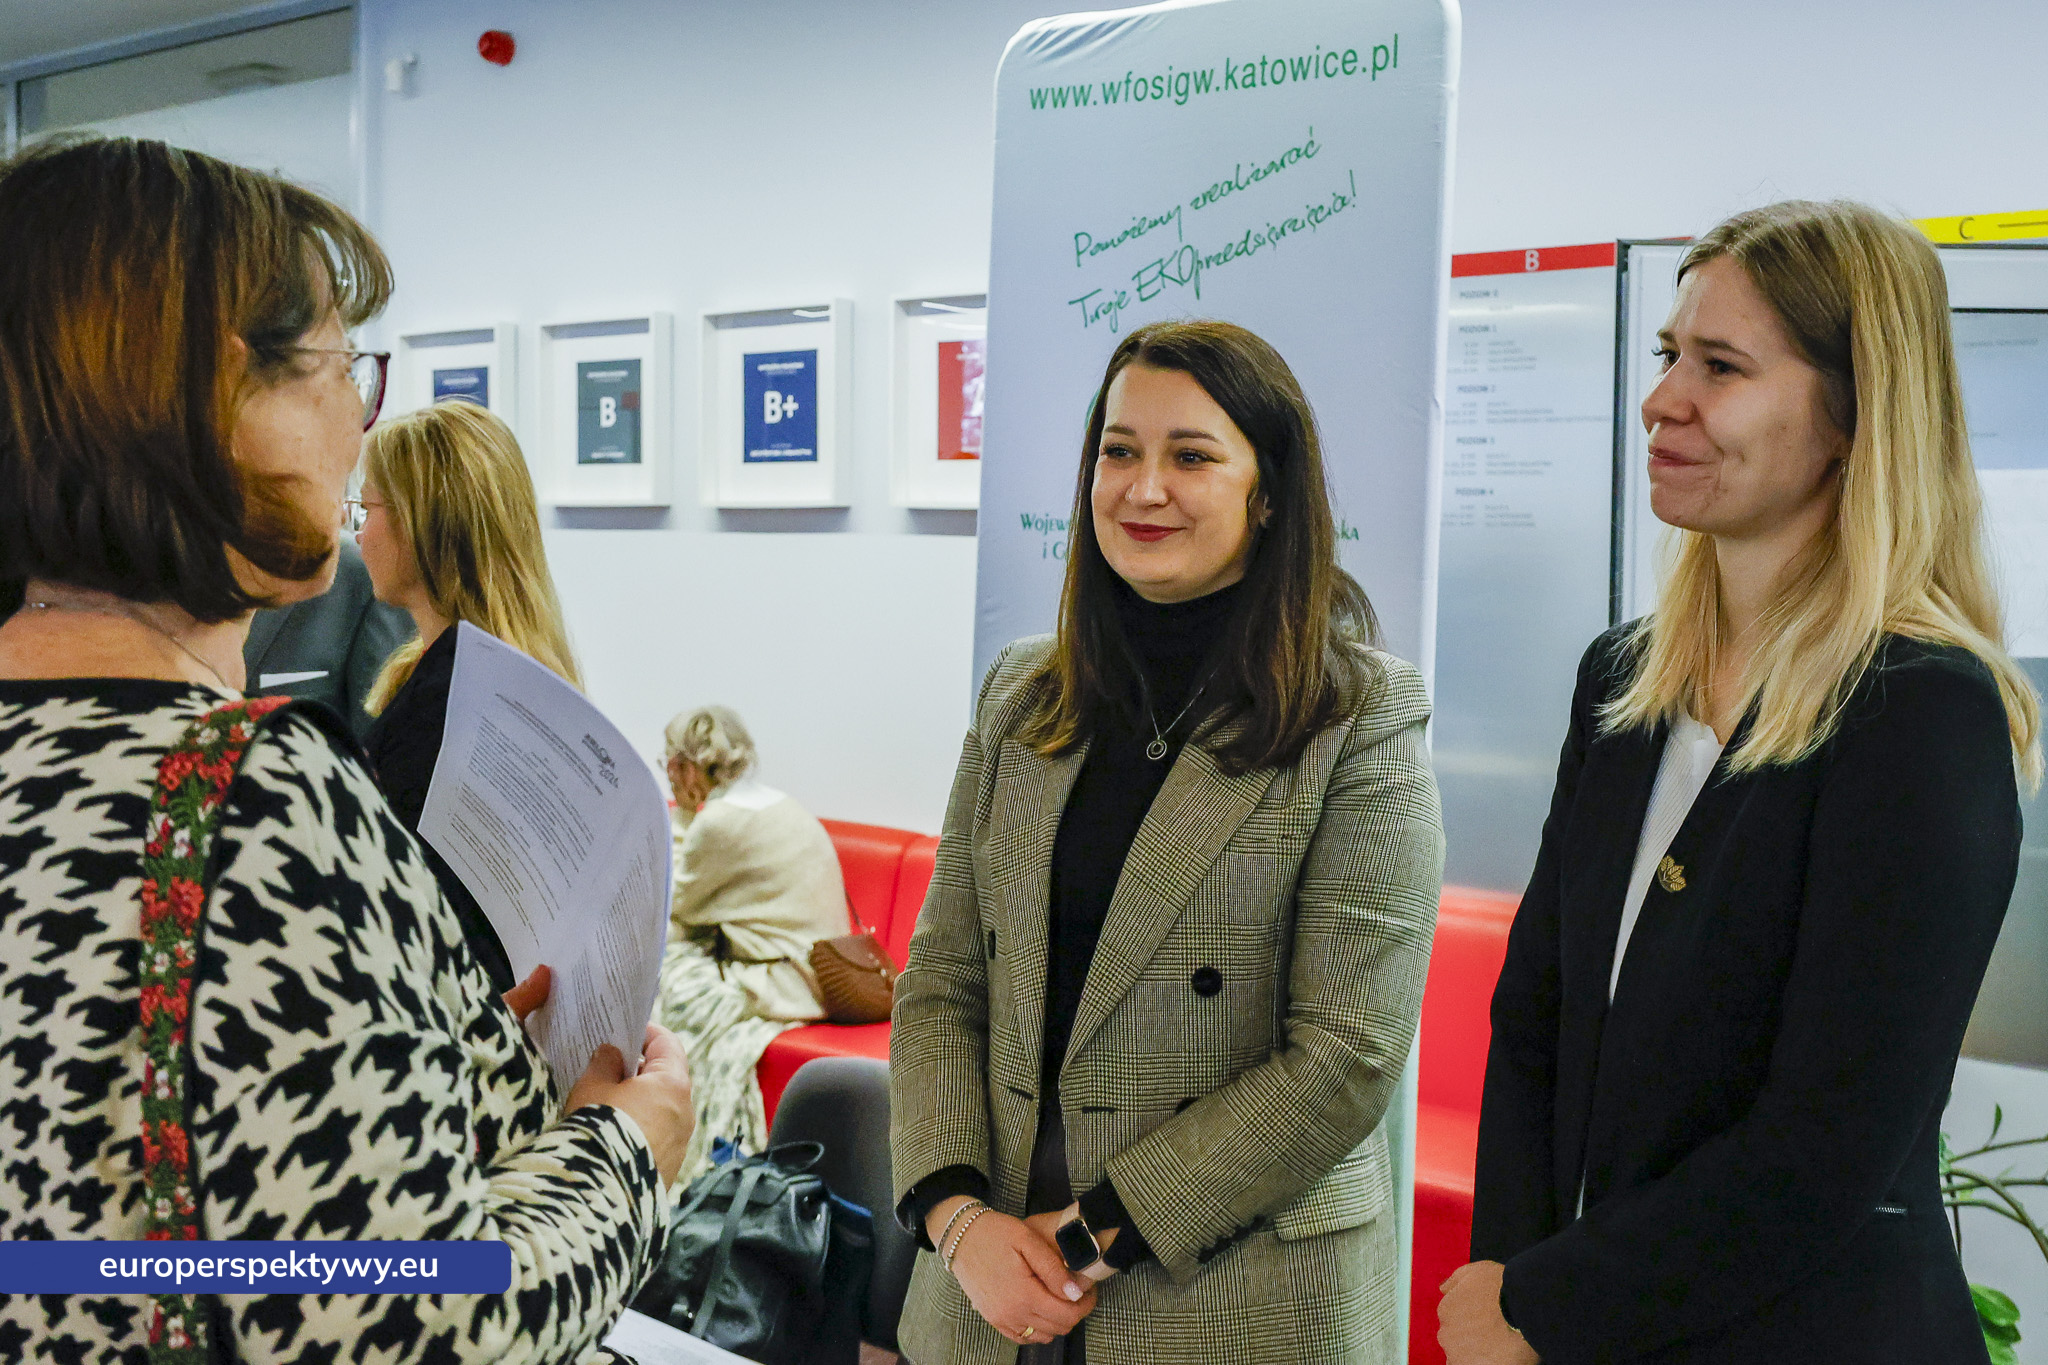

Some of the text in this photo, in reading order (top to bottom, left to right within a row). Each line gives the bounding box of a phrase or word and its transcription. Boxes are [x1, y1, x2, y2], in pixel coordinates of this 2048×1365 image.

[1029, 33, 1399, 110] www.wfosigw.katowice.pl
[1190, 125, 1322, 210] zrealizować
[1958, 216, 1975, 240] C
[1525, 250, 1540, 272] B
[1068, 288, 1132, 333] Twoje
[599, 396, 617, 428] B
[763, 390, 800, 425] B+
